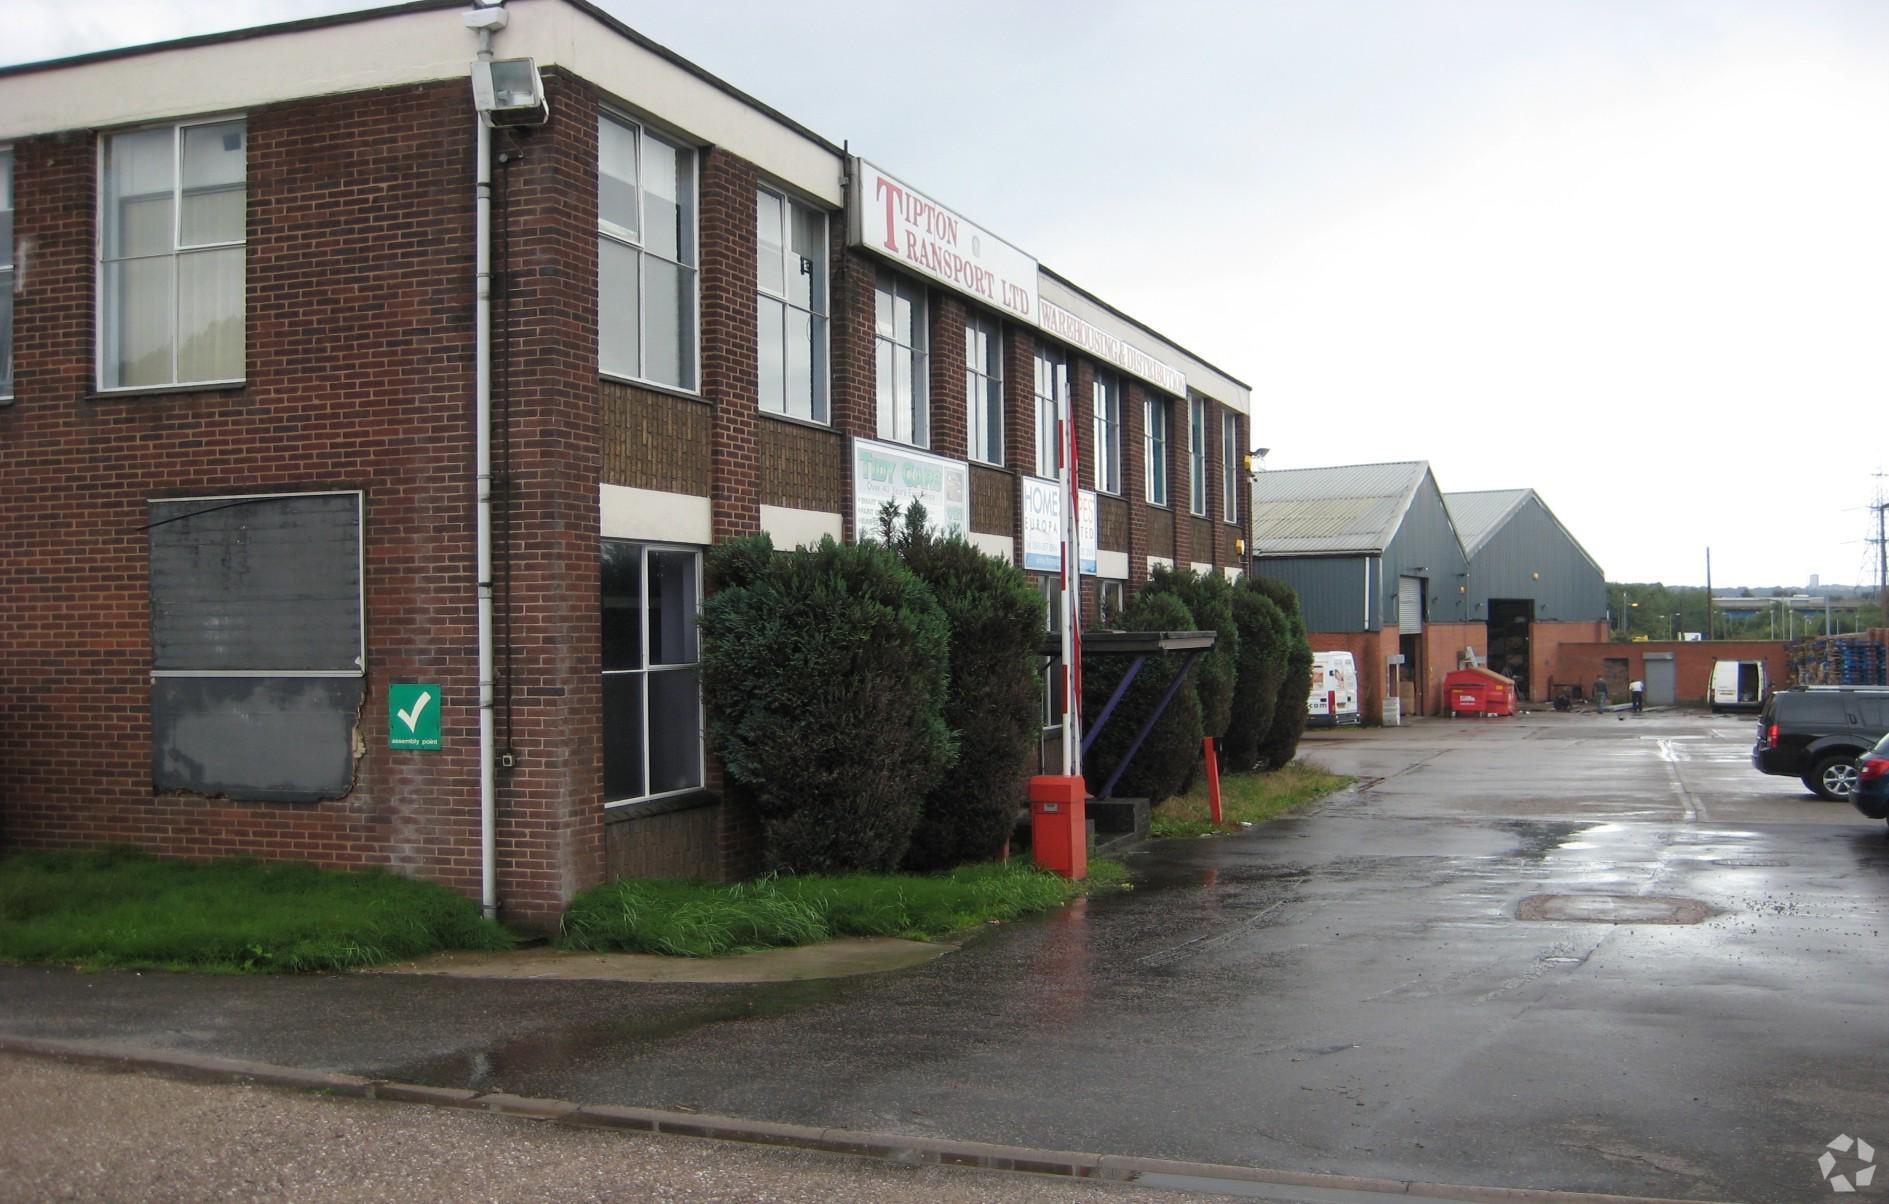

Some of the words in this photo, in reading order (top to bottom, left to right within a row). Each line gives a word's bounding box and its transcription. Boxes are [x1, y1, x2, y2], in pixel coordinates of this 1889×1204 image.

[877, 176, 958, 253] TIPTON
[1002, 279, 1029, 315] LTD
[1041, 302, 1119, 362] WAREHOUSING
[1127, 346, 1185, 394] DISTRIBUTION
[1024, 485, 1058, 517] HOME
[1024, 516, 1057, 535] EUROPA
